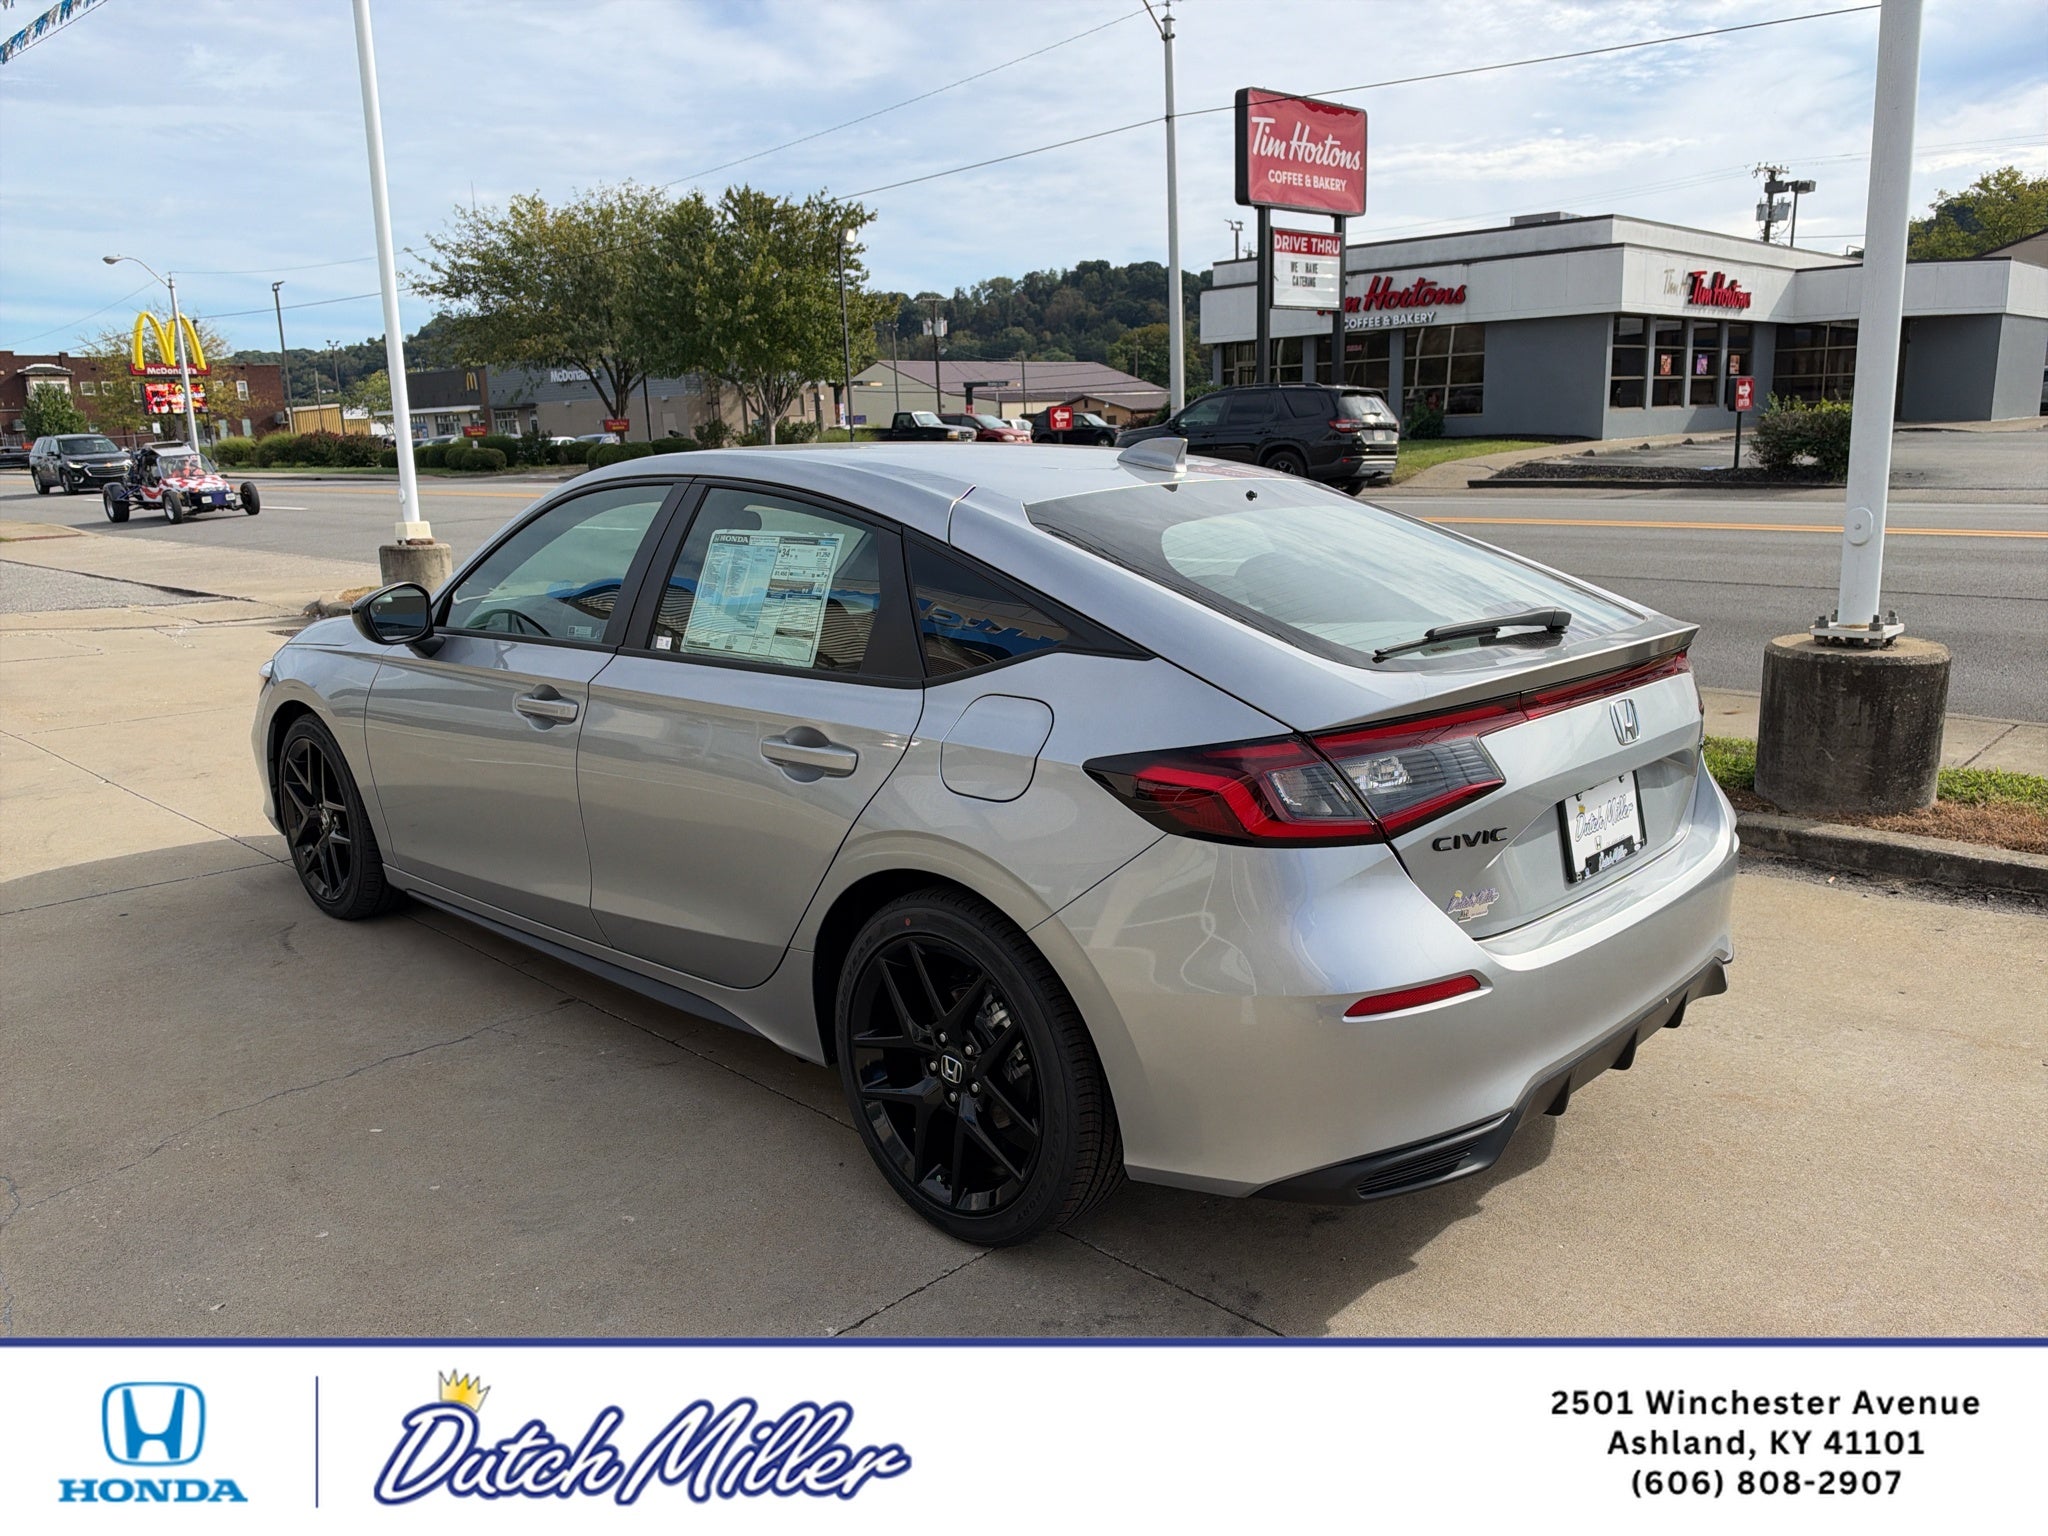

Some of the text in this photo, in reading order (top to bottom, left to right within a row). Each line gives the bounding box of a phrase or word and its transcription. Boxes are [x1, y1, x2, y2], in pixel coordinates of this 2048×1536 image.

[1251, 116, 1361, 171] Tim Hortons
[1268, 169, 1348, 192] COFFEE & BAKERY
[1274, 234, 1341, 255] DRIVE THRU
[1363, 275, 1467, 311] Hortons
[1688, 270, 1712, 305] Tim
[1711, 271, 1752, 309] Hortons
[1383, 314, 1390, 326] &
[1393, 312, 1435, 325] BAKERY
[720, 534, 749, 543] HONDA
[1605, 793, 1634, 826] Miller
[1432, 826, 1508, 852] CIVIC
